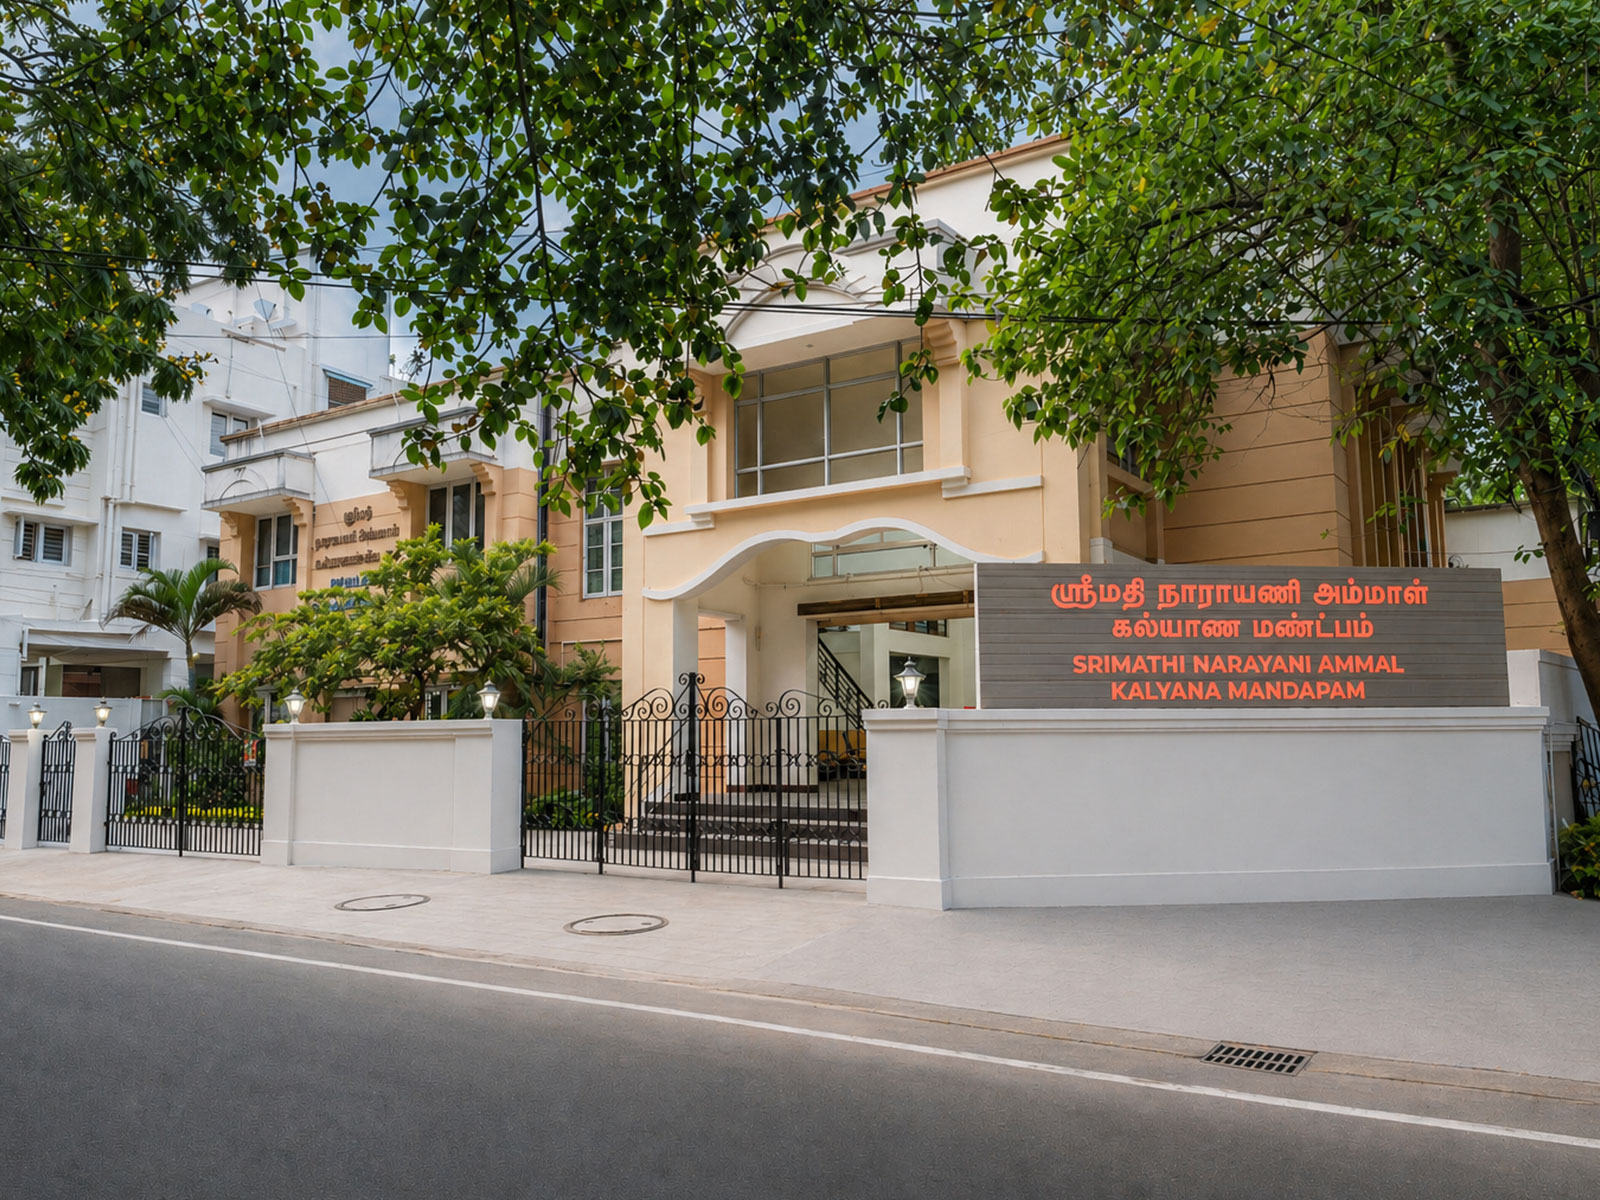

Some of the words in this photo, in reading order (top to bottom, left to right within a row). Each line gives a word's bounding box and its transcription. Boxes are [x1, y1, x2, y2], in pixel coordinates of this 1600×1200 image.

[1157, 578, 1301, 610] நாராயணி
[1313, 577, 1428, 605] அம்மாள்
[1112, 611, 1240, 638] கல்யாண
[1073, 655, 1185, 674] SRIMATHI
[1193, 655, 1311, 674] NARAYANI
[1318, 655, 1405, 674] AMMAL
[1111, 681, 1221, 700] KALYANA
[1228, 681, 1365, 700] MANDAPAM
